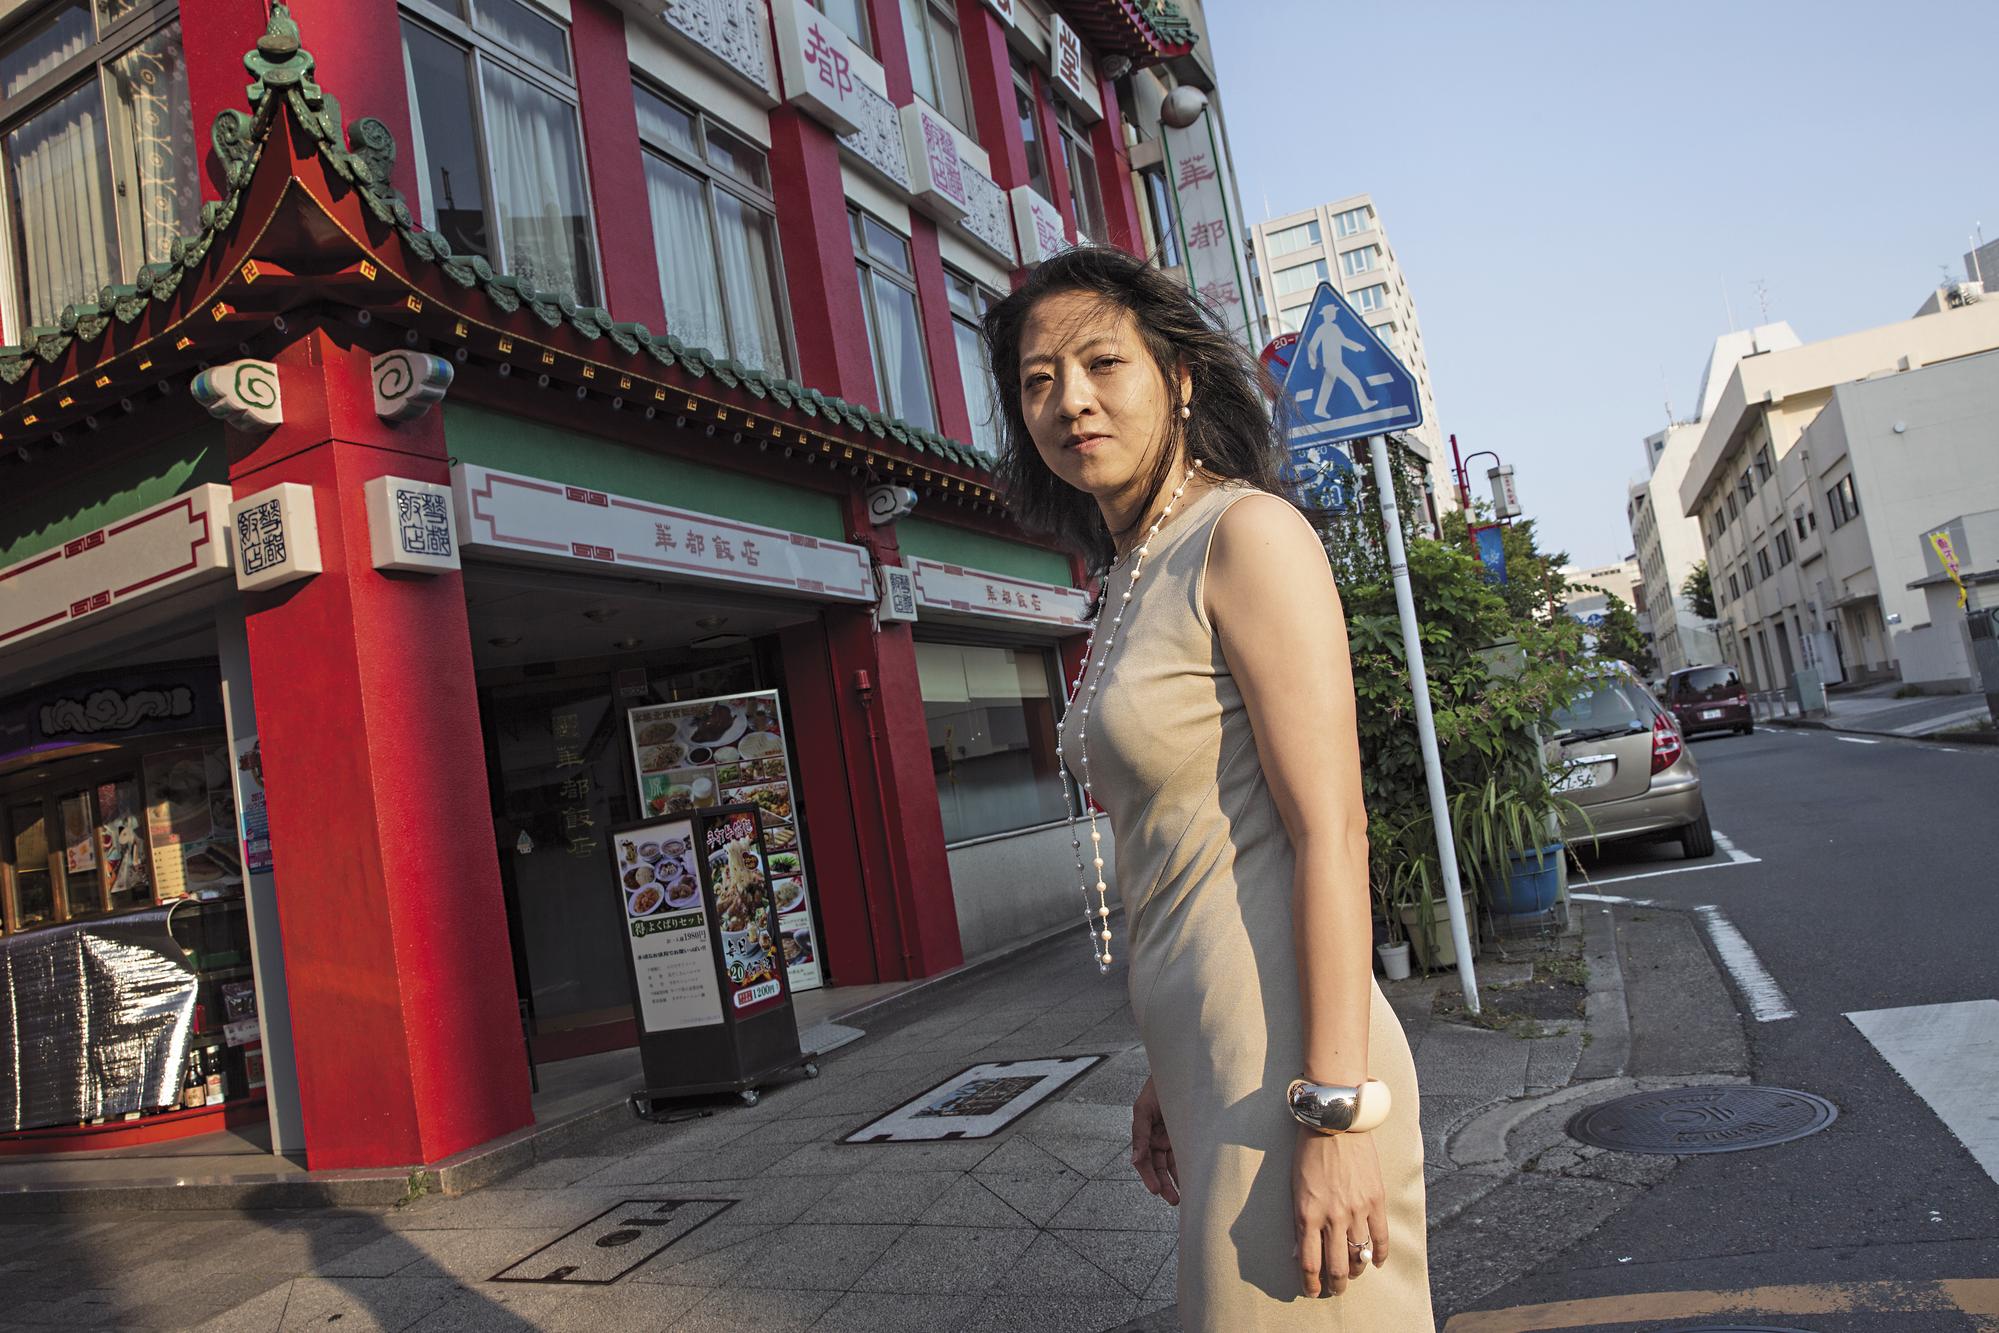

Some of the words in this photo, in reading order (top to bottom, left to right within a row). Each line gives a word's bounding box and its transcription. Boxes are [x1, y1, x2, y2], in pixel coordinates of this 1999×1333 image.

[804, 23, 853, 101] 都
[655, 522, 760, 567] 華都飯店
